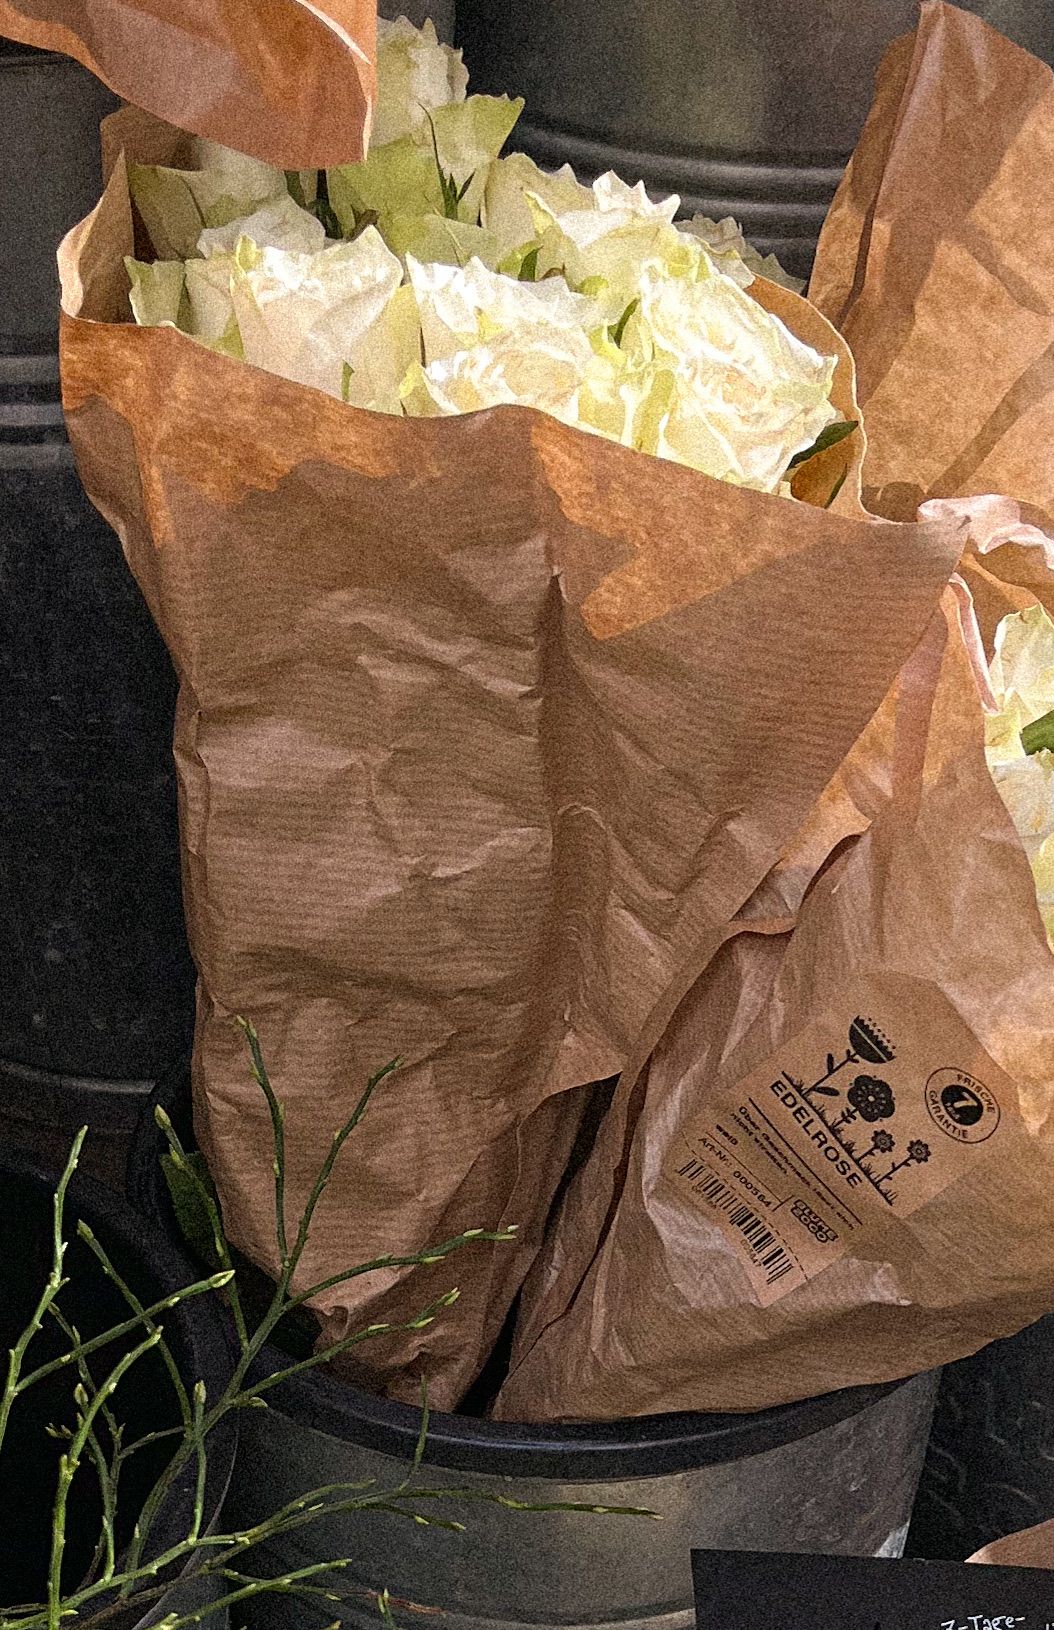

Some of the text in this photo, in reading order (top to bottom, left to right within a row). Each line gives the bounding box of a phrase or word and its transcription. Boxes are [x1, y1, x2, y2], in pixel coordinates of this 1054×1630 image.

[928, 1090, 969, 1139] GARANTIE
[953, 1091, 978, 1109] 7
[957, 1073, 996, 1114] FRISCHE
[770, 1079, 863, 1189] EDELROSE
